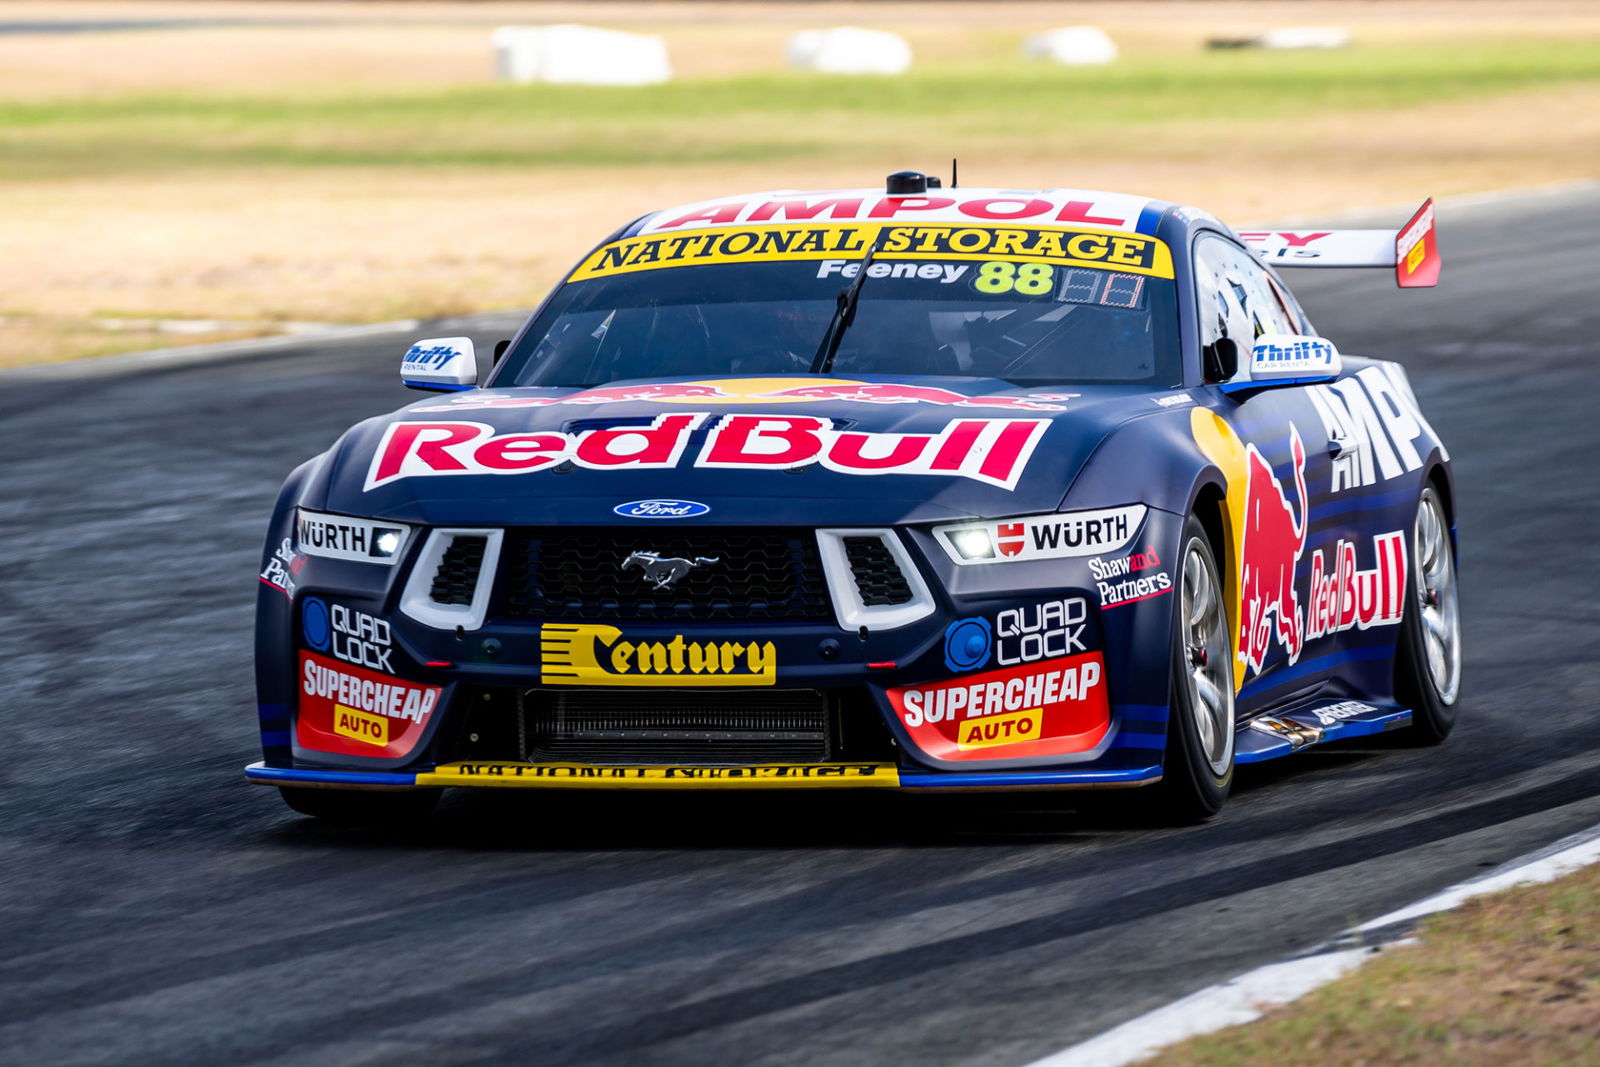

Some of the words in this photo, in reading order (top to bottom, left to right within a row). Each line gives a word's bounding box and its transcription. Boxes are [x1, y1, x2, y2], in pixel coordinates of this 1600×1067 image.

[656, 196, 1126, 230] AMPOL
[591, 228, 865, 272] NATIONAL
[882, 227, 1146, 266] STORAGE
[816, 259, 970, 284] Feeney
[975, 261, 1054, 296] 88
[1253, 342, 1332, 365] Thrifty
[364, 413, 709, 491] Red
[695, 413, 1052, 491] Bull
[631, 502, 692, 516] Ford
[1031, 514, 1127, 551] WÜRTH
[1097, 572, 1172, 606] Partners
[1306, 539, 1344, 641] Red
[1337, 530, 1408, 631] Bull
[331, 604, 391, 646] QUAD
[997, 597, 1087, 636] QUAD
[333, 633, 396, 675] LOCK
[541, 623, 776, 686] Century
[997, 624, 1087, 665] LOCK
[303, 659, 436, 724] SUPERCHEAP
[903, 661, 1100, 727] SUPERCHEAP
[339, 713, 383, 739] AUTO
[966, 717, 1033, 743] AUTO
